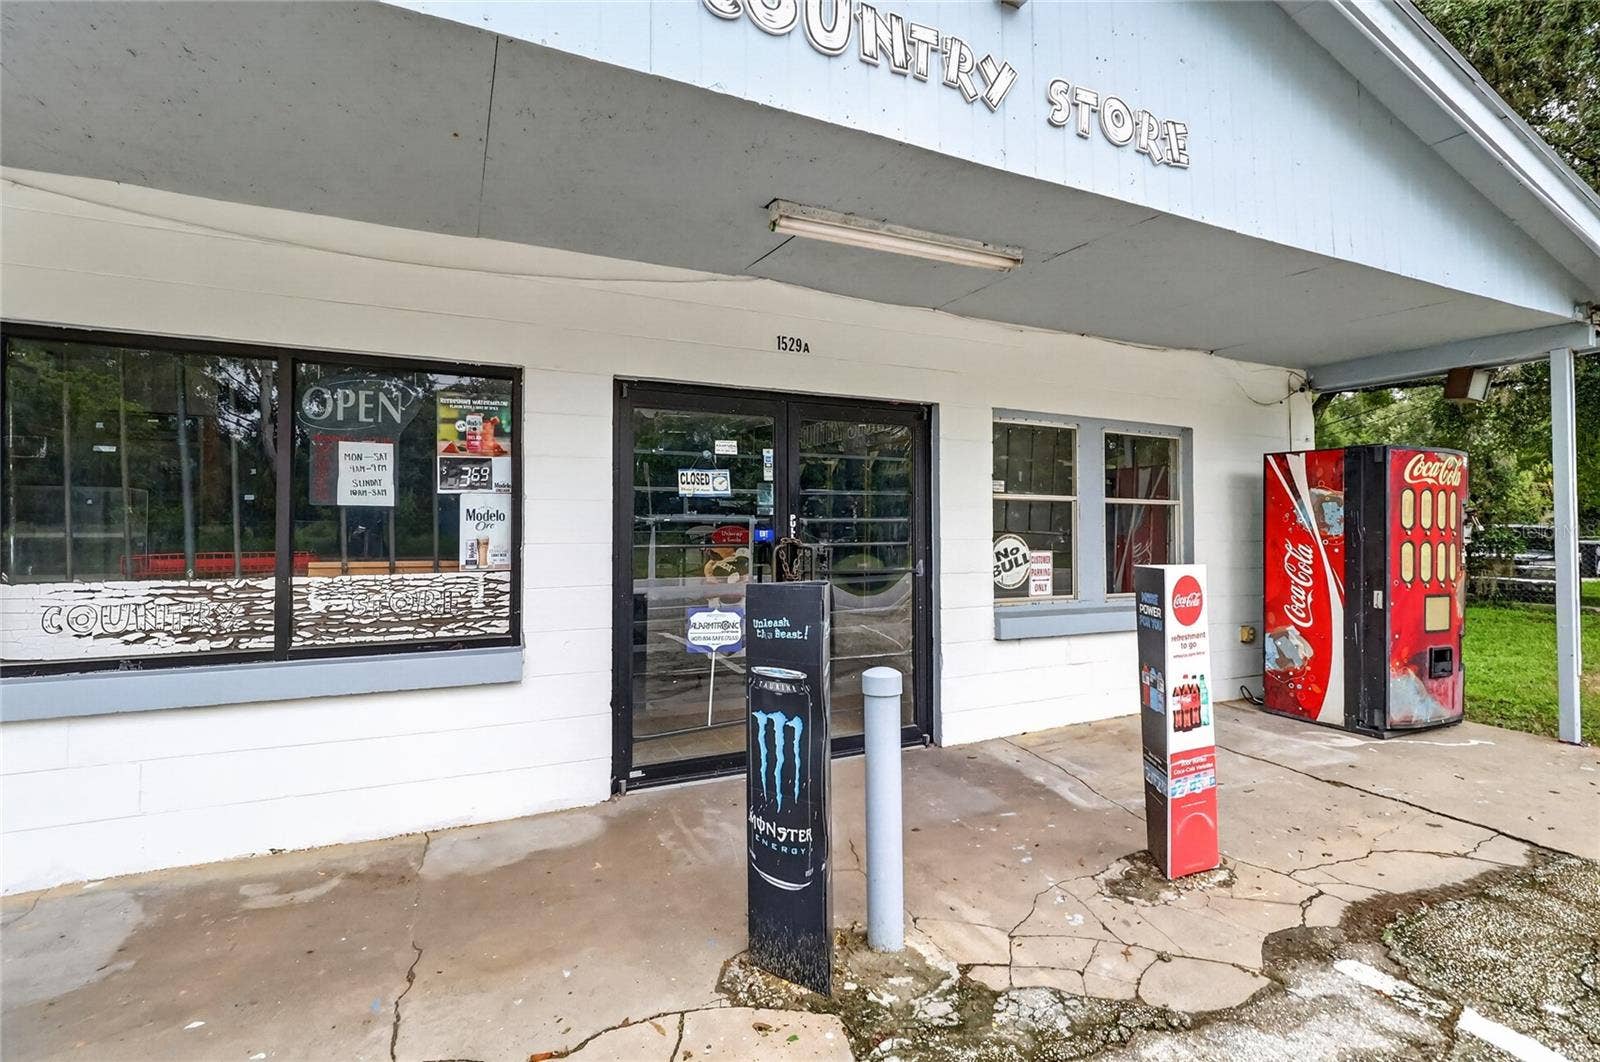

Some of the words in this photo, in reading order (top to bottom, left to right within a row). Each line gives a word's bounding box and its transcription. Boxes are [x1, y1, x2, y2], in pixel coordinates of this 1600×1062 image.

[1046, 78, 1190, 168] STORE
[776, 335, 810, 354] 1529A
[301, 386, 403, 424] OPEN
[352, 478, 382, 488] SUNDAY
[680, 472, 710, 486] CLOSED
[465, 508, 506, 522] Modelo
[993, 553, 1030, 578] BULL
[1031, 568, 1051, 577] PARKING
[1034, 583, 1047, 592] ONLY
[41, 600, 244, 634] COUNTRY
[1139, 604, 1162, 619] POWER
[753, 617, 791, 628] Unleash
[775, 625, 809, 640] Beast!
[1171, 632, 1206, 642] refreshment
[1188, 641, 1197, 649] go
[749, 810, 813, 843] MONSTER
[755, 836, 806, 856] ENERGY
